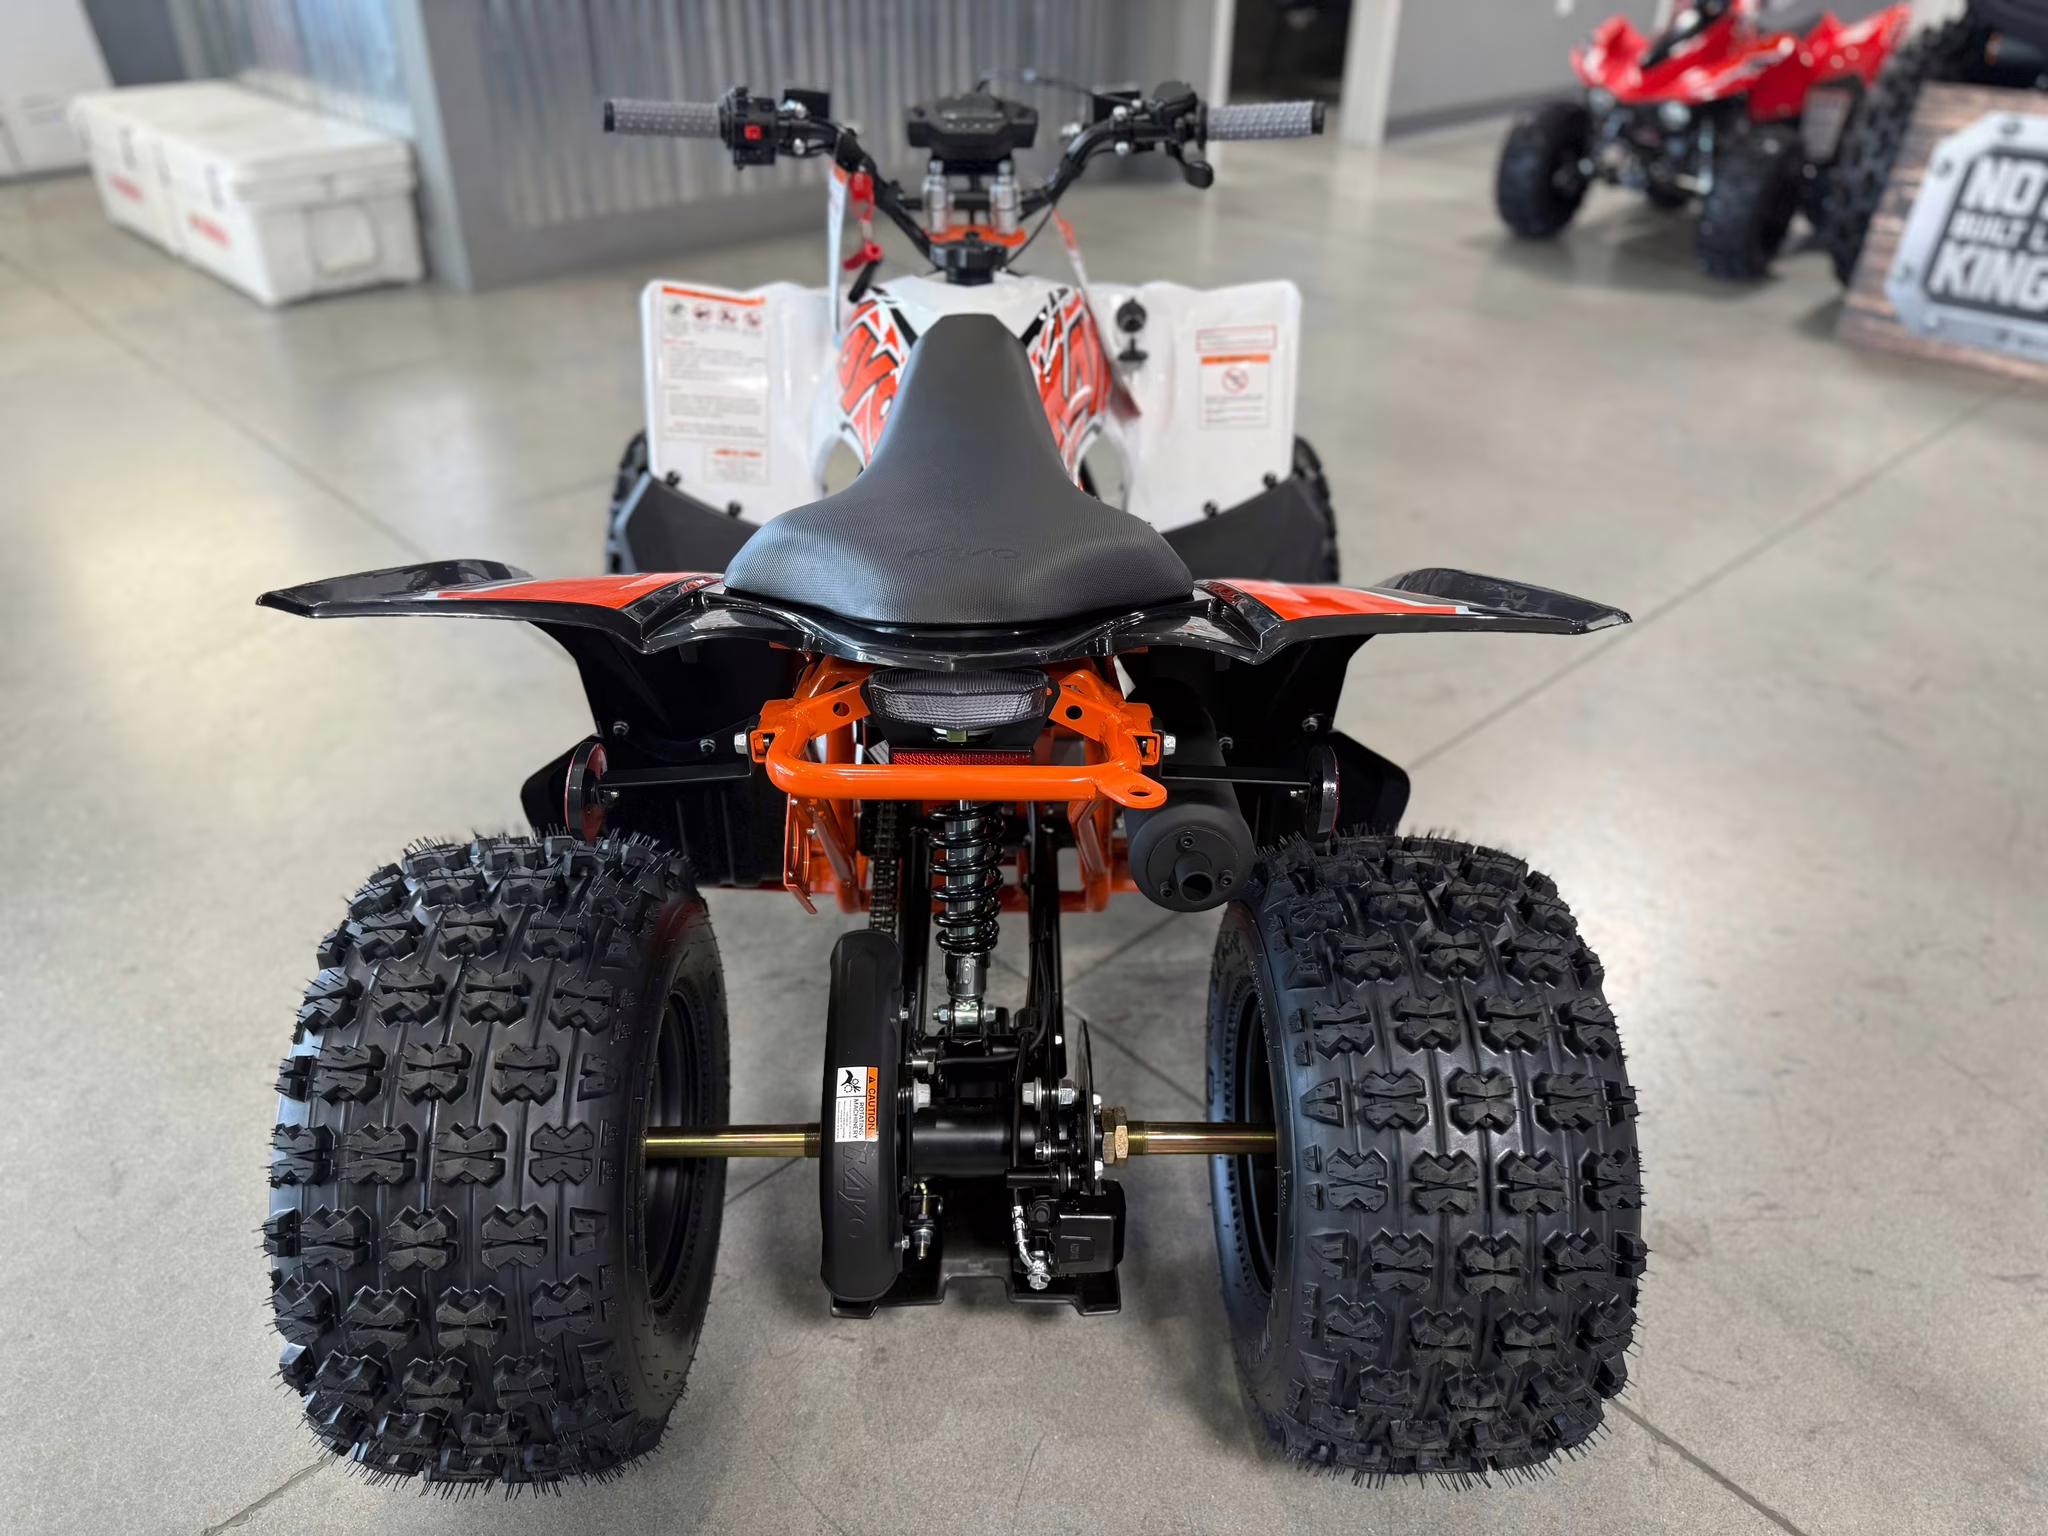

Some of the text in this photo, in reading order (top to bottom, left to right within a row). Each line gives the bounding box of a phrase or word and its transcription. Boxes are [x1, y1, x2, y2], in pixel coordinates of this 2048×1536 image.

[1959, 156, 2048, 220] NO
[1949, 210, 2028, 247] BUILT
[868, 1088, 876, 1130] CAUTION
